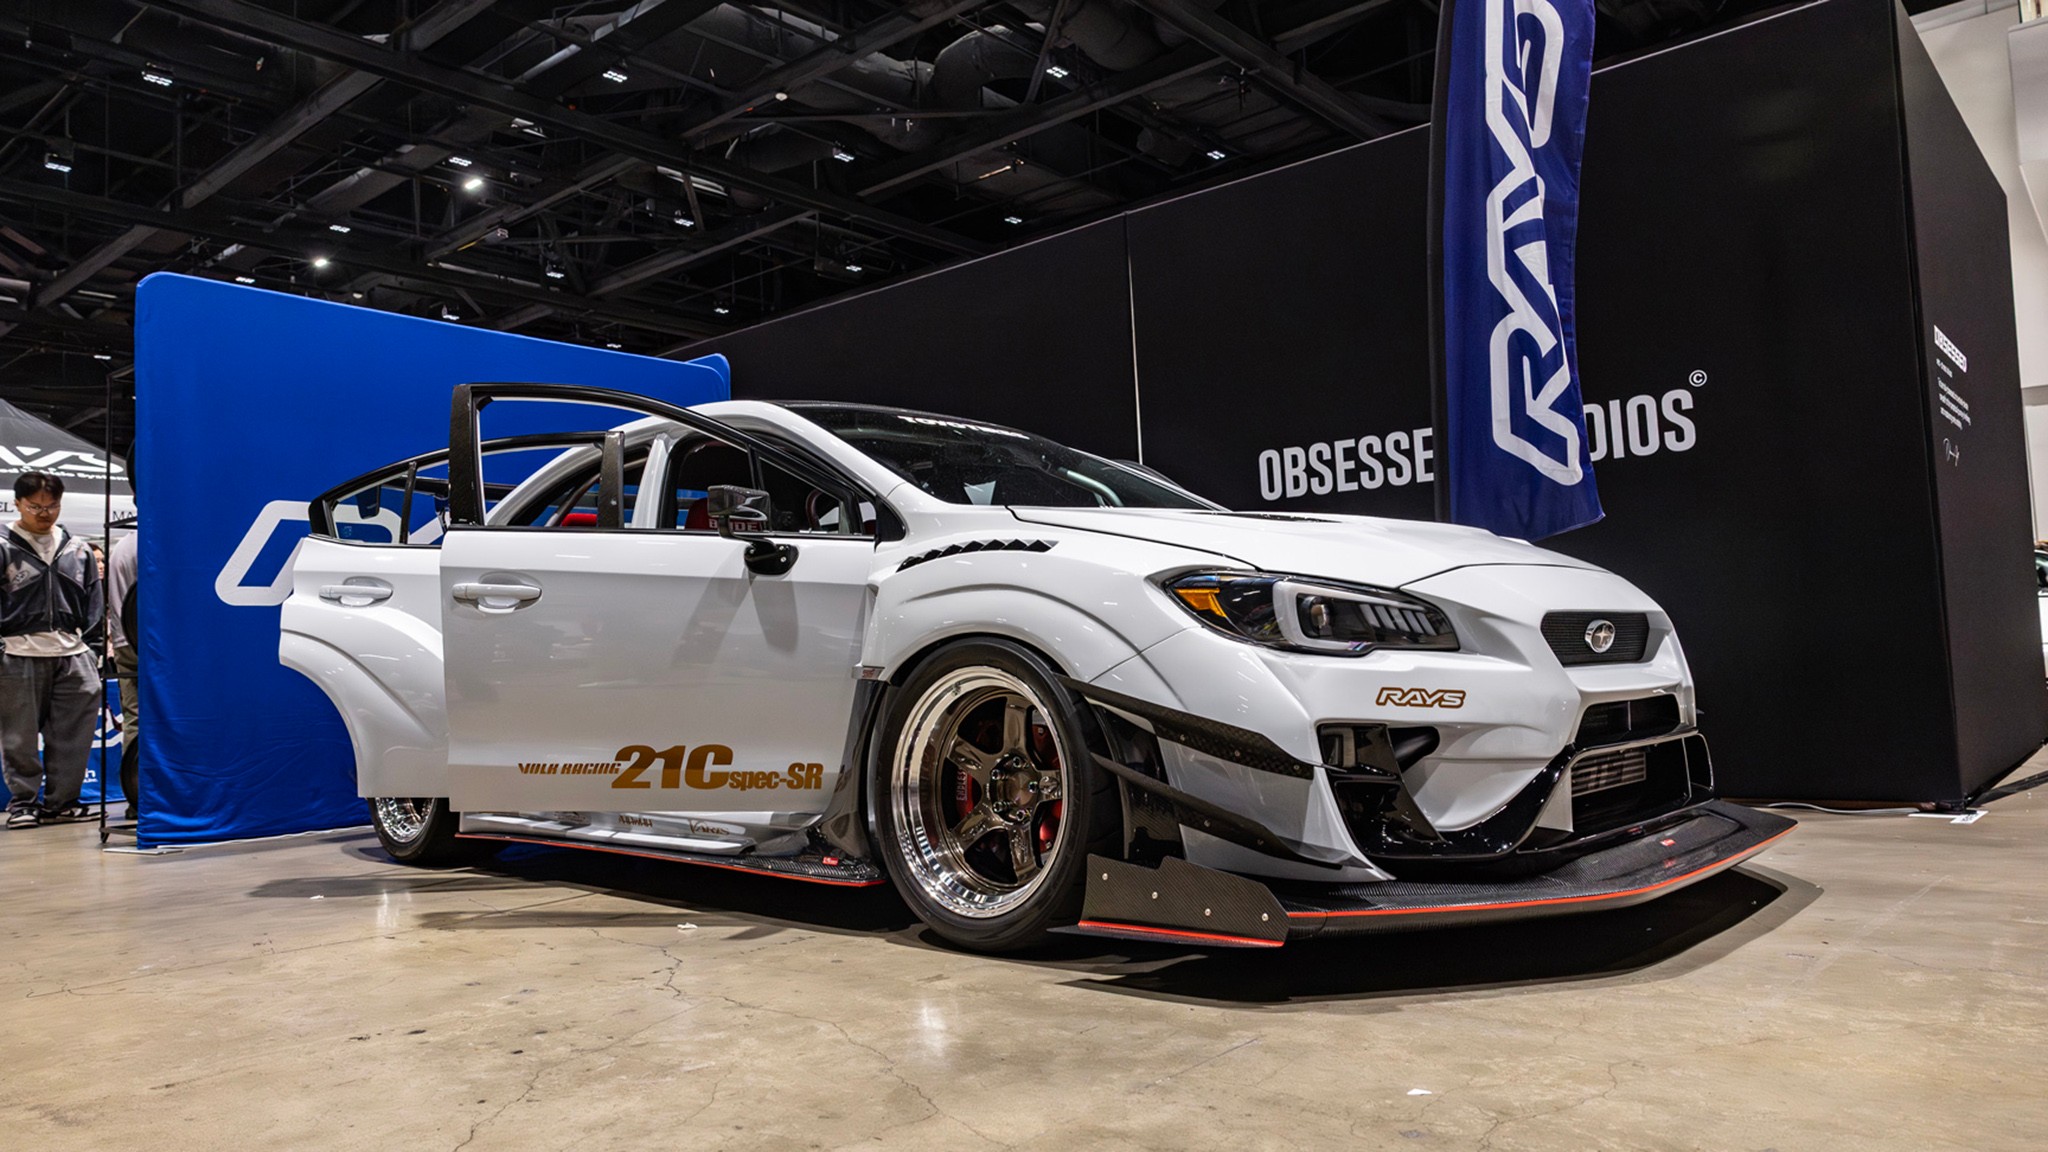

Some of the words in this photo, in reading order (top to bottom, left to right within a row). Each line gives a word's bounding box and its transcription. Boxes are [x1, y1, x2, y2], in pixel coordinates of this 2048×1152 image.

[1259, 427, 1435, 501] OBSESSE
[1582, 388, 1697, 463] DIOS
[709, 519, 758, 531] BIDE
[1375, 686, 1467, 709] RAYS
[517, 762, 558, 775] VOLK
[560, 762, 622, 775] RACING
[611, 743, 734, 790] 21C
[728, 762, 824, 791] spec-SR
